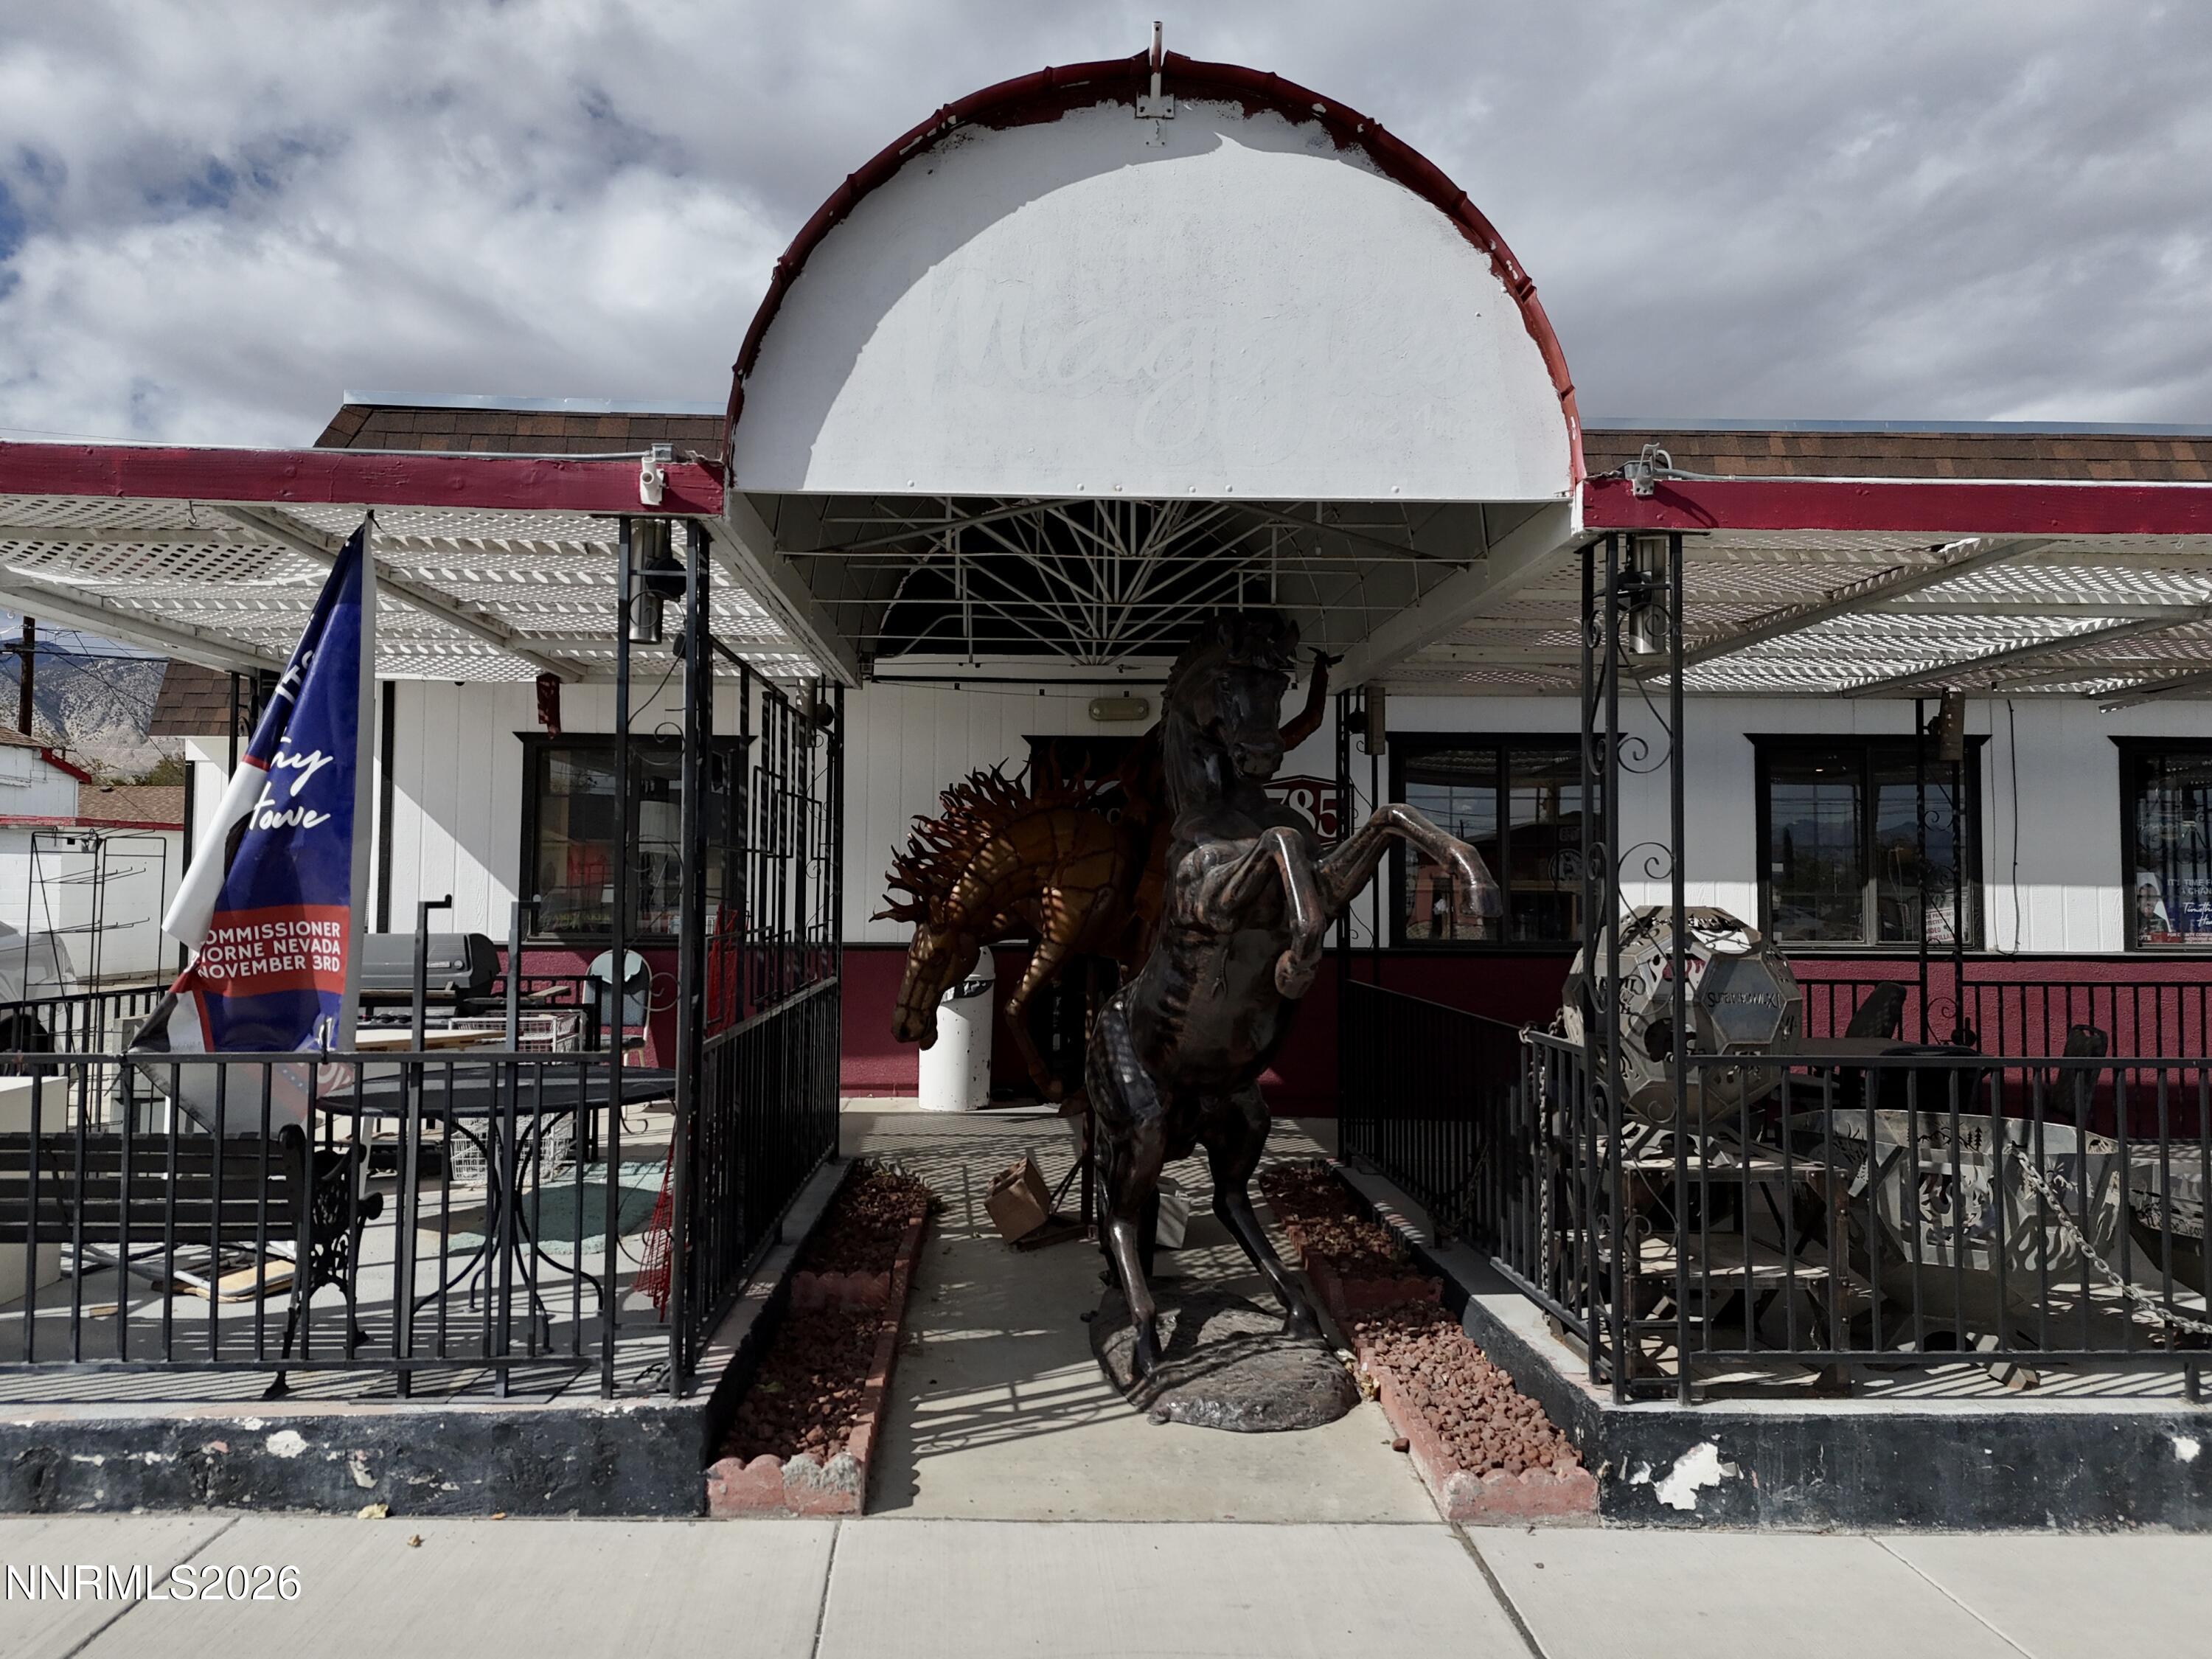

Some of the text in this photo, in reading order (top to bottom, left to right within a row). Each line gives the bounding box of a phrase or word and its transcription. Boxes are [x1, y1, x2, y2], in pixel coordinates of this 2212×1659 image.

[2183, 878, 2205, 886] TIME
[206, 921, 341, 945] OMMISSIONER
[203, 938, 341, 962] ORNE NEVADA
[198, 955, 340, 979] NOVEMBER 3RD
